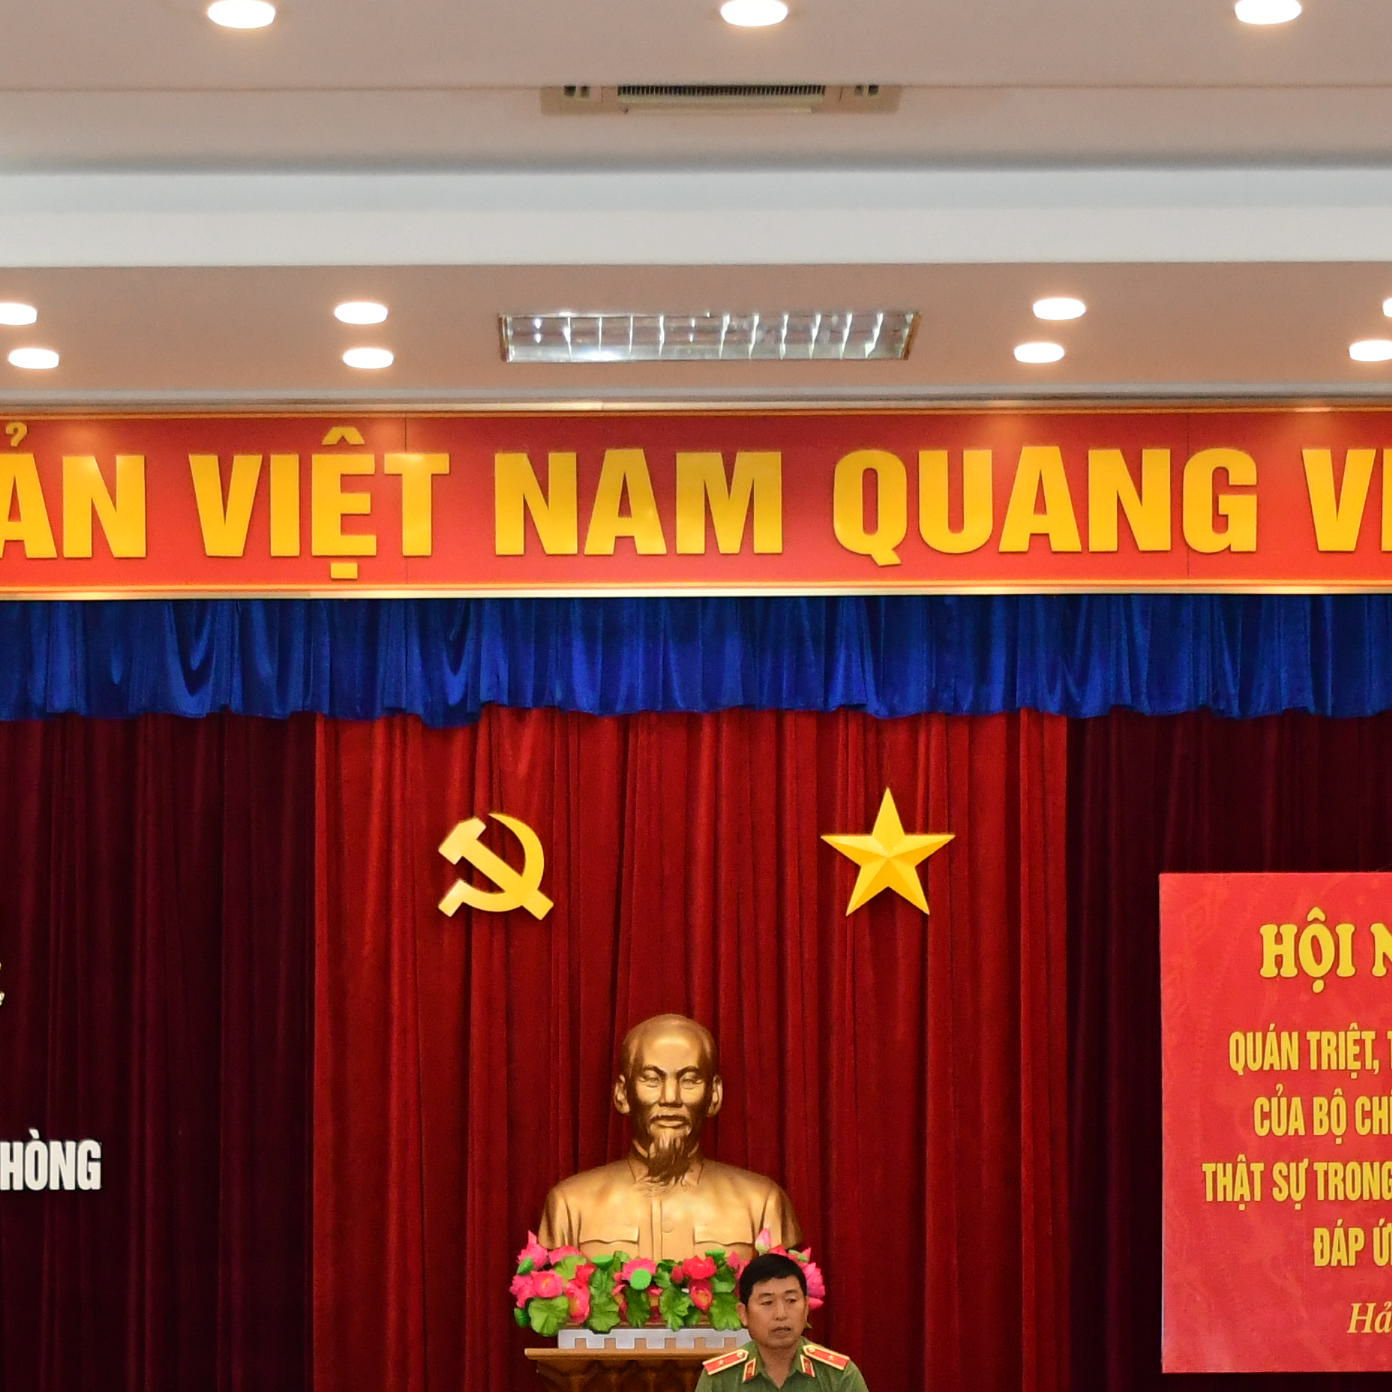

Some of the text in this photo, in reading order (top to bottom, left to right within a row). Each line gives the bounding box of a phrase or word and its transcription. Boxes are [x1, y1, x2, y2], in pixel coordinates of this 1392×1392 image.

[189, 426, 451, 580] VIỆT
[494, 449, 784, 557] NAM
[833, 446, 1258, 566] QUANG
[1259, 907, 1356, 993] HỘI
[1229, 1024, 1300, 1076] QUÁN
[1307, 1023, 1381, 1079] TRIỆT,
[1253, 1084, 1306, 1138] CỦA
[1314, 1088, 1348, 1145] BỘ
[1202, 1154, 1265, 1211] THẬT
[1272, 1159, 1309, 1210] SỰ
[1313, 1219, 1366, 1268] ĐÁP
